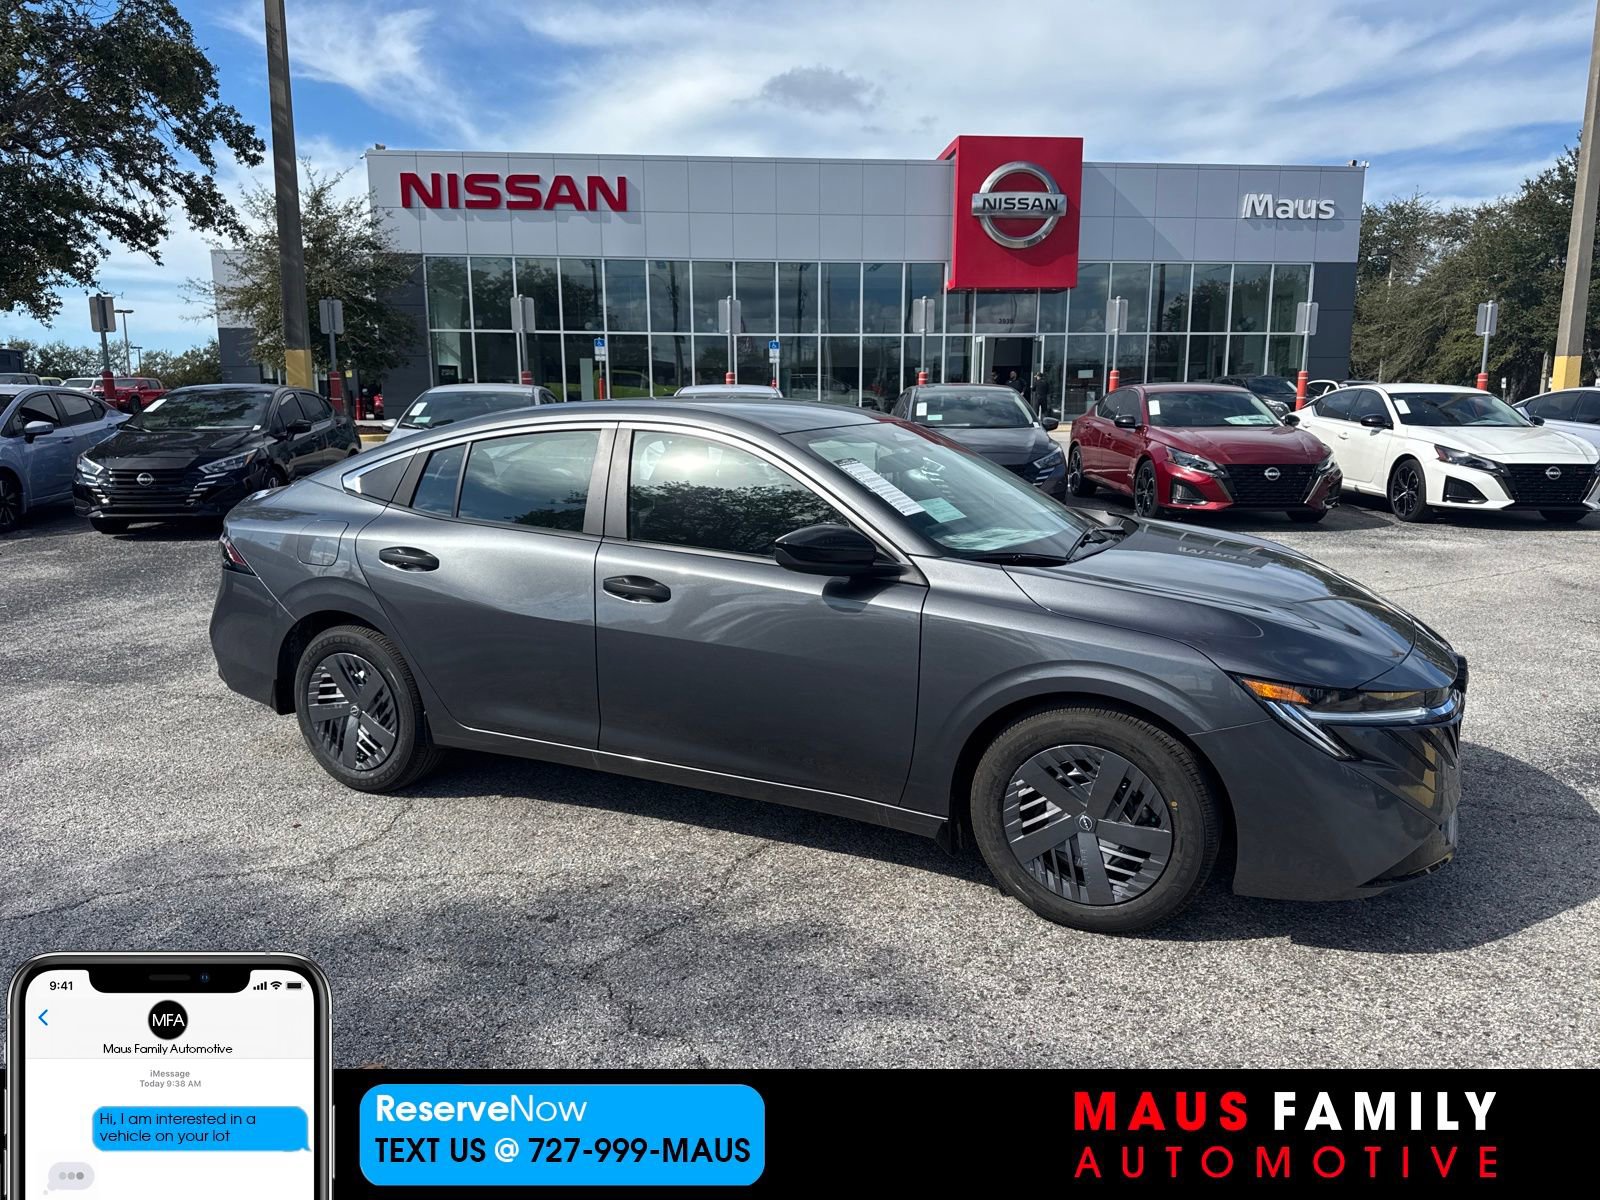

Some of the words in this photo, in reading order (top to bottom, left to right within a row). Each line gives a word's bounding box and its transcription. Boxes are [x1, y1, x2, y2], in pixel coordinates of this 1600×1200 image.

[400, 172, 627, 212] NISSAN
[982, 196, 1058, 212] NISSAN
[1242, 193, 1336, 220] Maus
